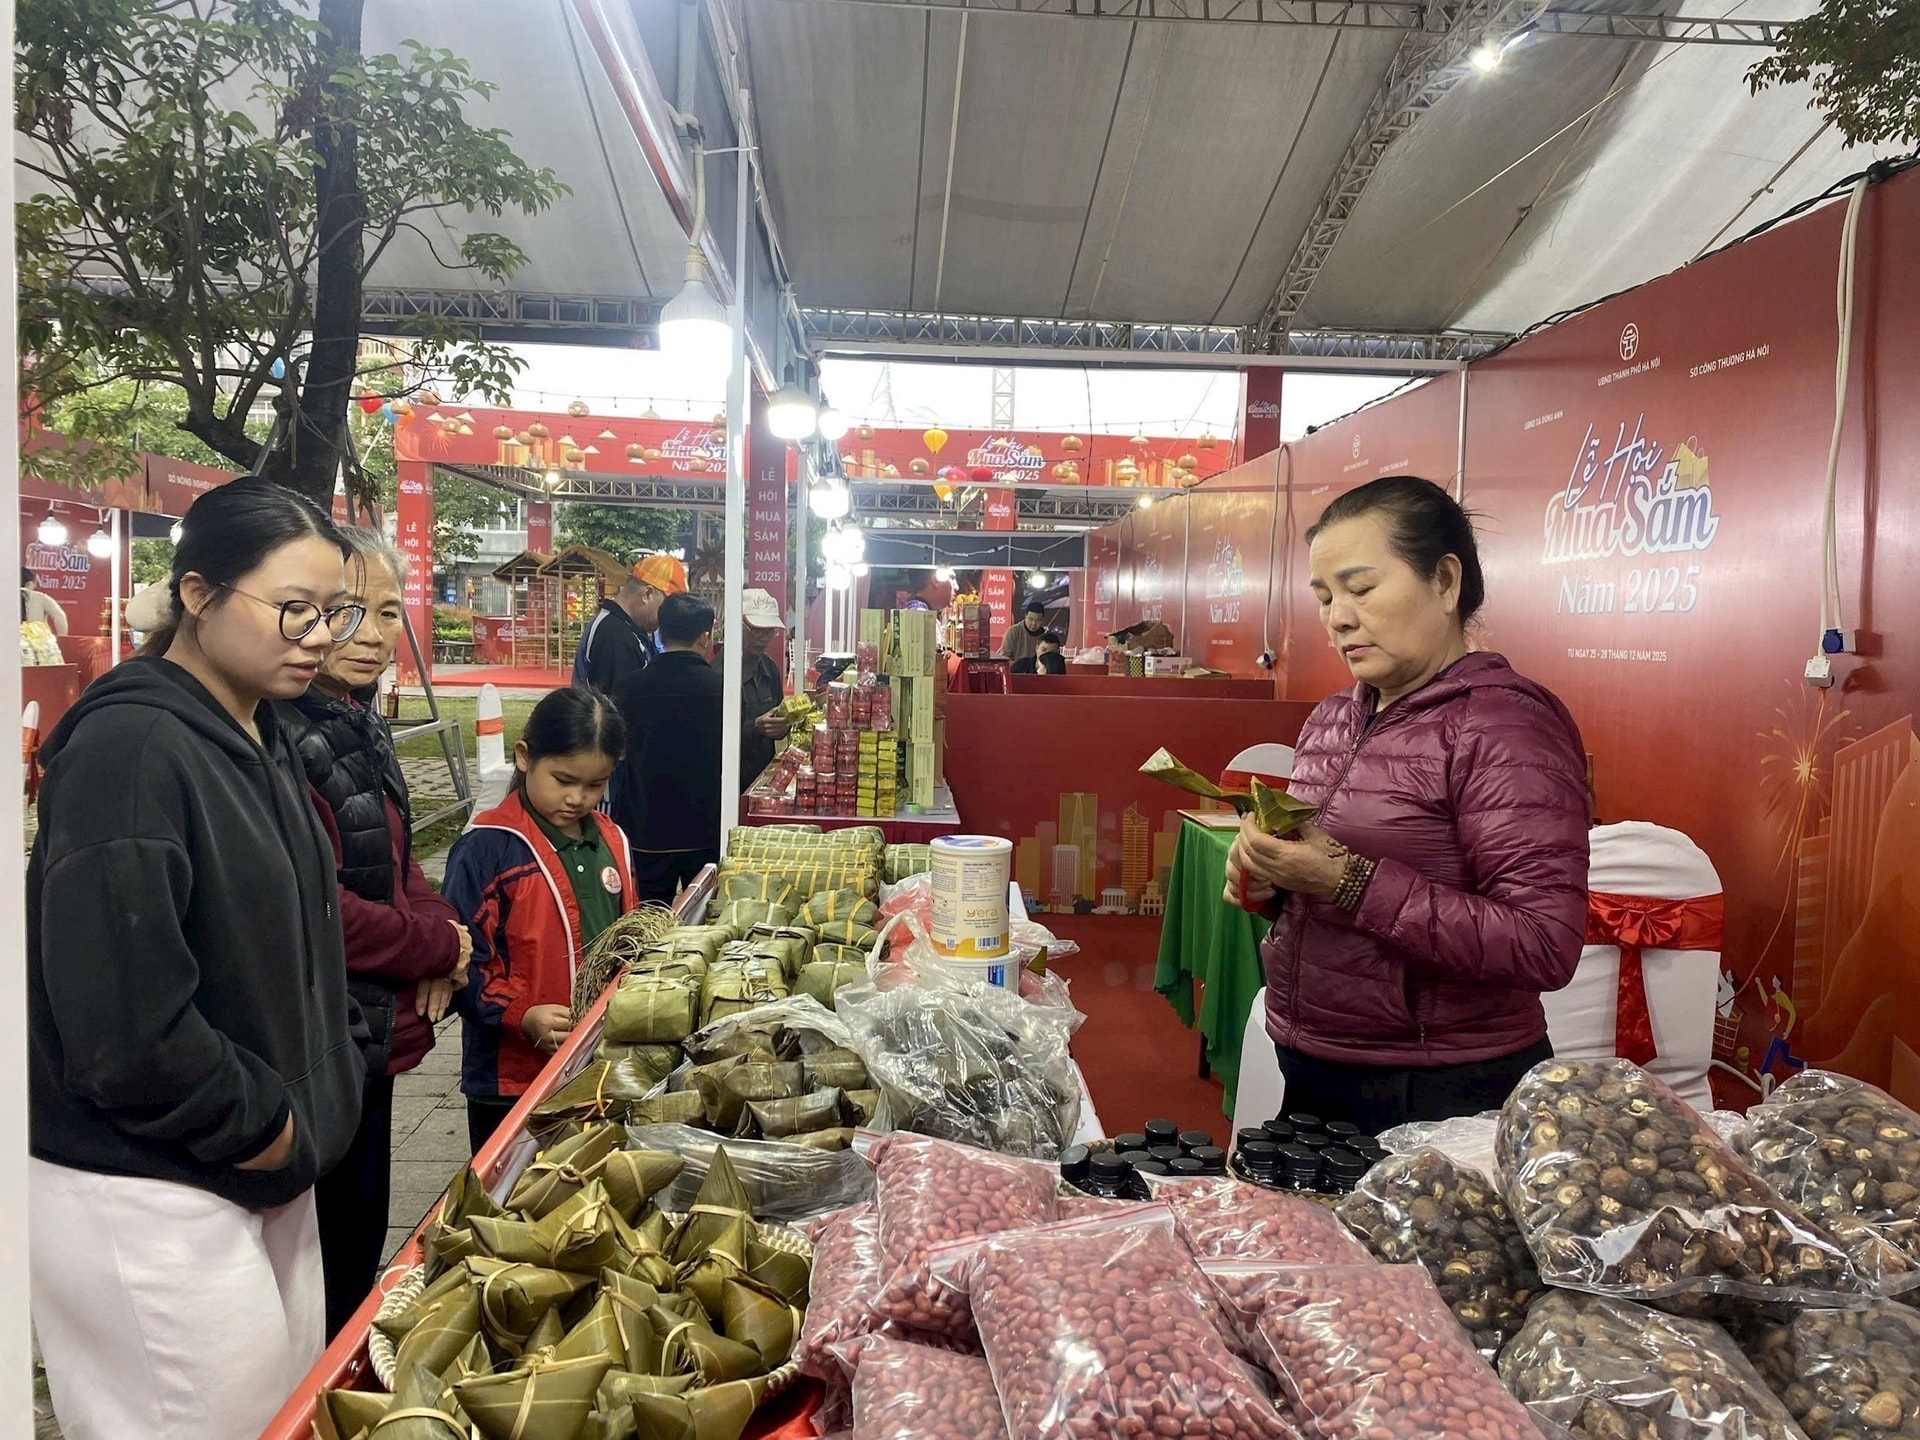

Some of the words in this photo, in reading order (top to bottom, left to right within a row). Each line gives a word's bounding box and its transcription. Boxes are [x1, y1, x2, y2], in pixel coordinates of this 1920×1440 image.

[1689, 364, 1699, 378] SỞ
[1699, 361, 1717, 375] CÔNG
[1717, 352, 1745, 370] THƯƠNG
[1745, 347, 1756, 361] HÀ
[1756, 343, 1770, 358] NỘI
[966, 448, 1005, 467] Mua
[1564, 422, 1600, 510] Lễ
[1600, 411, 1664, 502] Hội
[706, 461, 727, 473] 202
[761, 467, 776, 481] LỄ
[758, 489, 778, 503] HỘI
[755, 510, 781, 522] MUA
[1542, 487, 1617, 565] Mua
[1619, 459, 1721, 557] Sắm
[25, 543, 58, 569] Mua
[59, 545, 91, 572] Sắm
[36, 573, 58, 588] Năm
[60, 575, 87, 590] 2025
[755, 571, 781, 582] 2025
[989, 574, 1006, 582] MUA
[1556, 574, 1617, 616] Năm
[1622, 565, 1702, 615] 2025
[1629, 650, 1637, 660] 12
[1652, 650, 1668, 662] 2025
